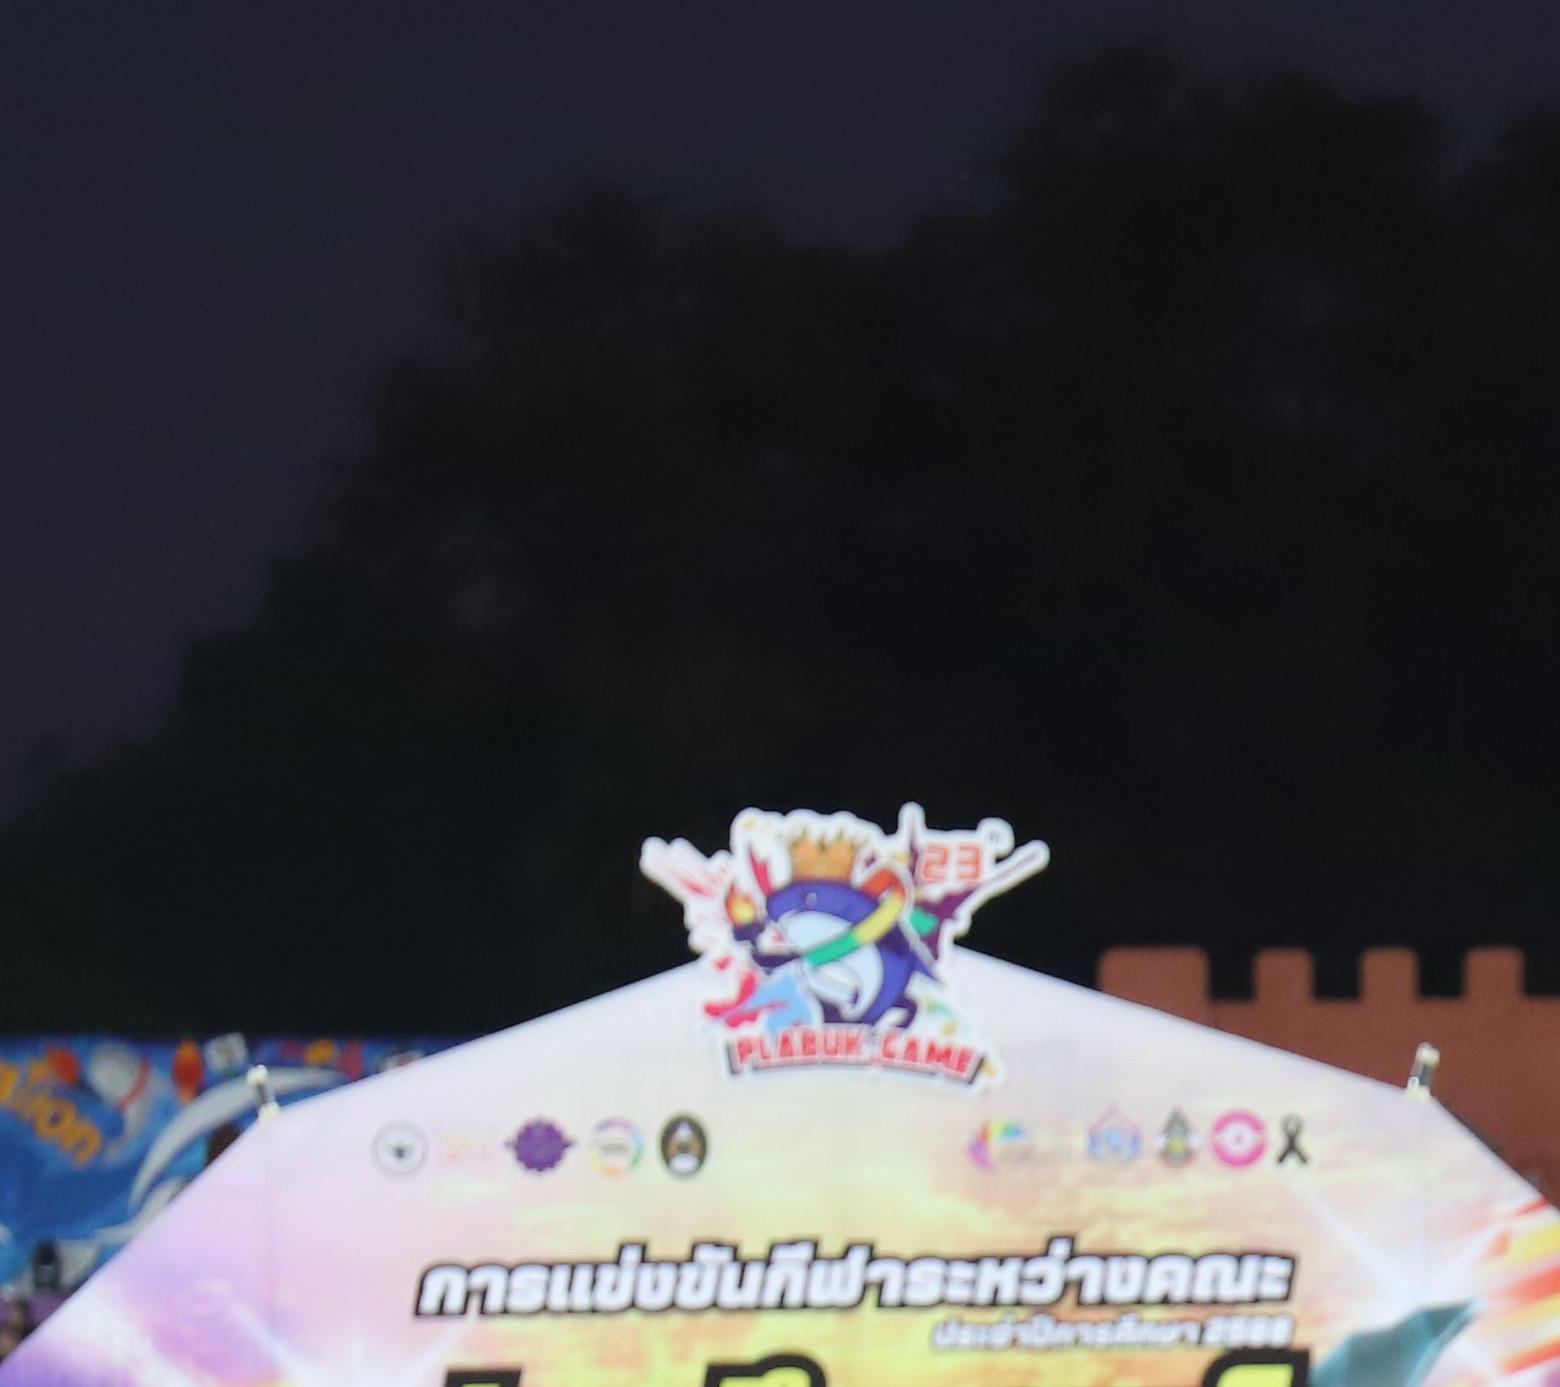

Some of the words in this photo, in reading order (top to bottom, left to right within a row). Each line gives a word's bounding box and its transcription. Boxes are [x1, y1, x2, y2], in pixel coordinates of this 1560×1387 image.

[415, 1237, 1295, 1316] การแข่งขันกีฬาระหว่างคณะ
